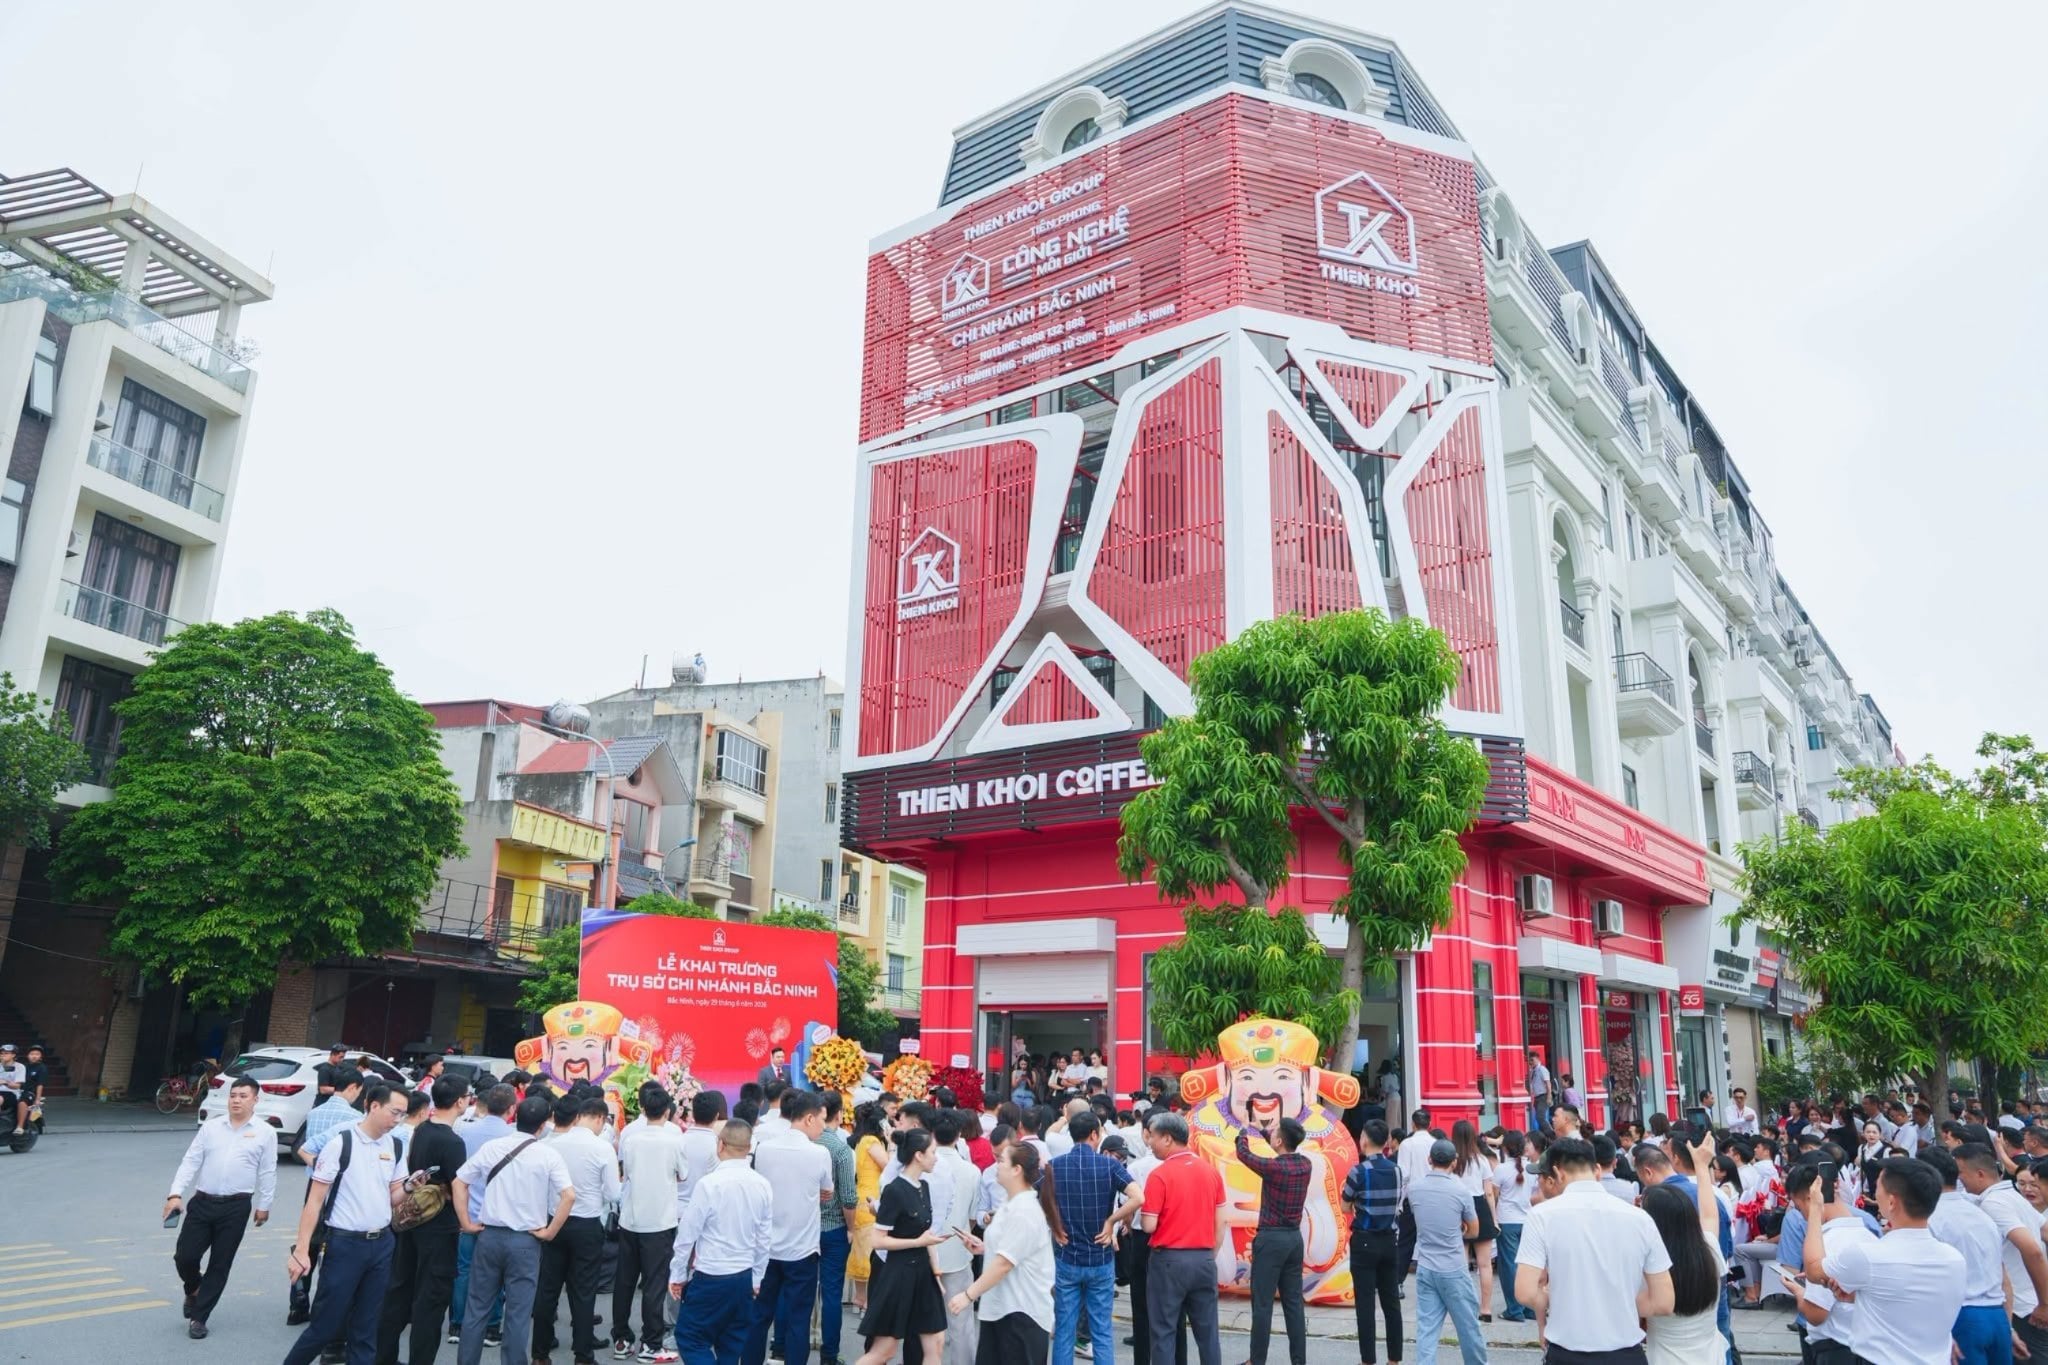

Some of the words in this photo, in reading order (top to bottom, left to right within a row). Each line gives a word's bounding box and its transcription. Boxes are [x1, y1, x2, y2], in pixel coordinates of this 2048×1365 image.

[963, 215, 1003, 241] THIEN
[1006, 198, 1046, 224] KHOI
[1049, 173, 1106, 205] GROUP
[1057, 201, 1103, 226] PHONG
[1002, 237, 1061, 275] CÔNG
[1067, 205, 1130, 249] NGHỆ
[1036, 257, 1062, 277] MÔI
[1320, 263, 1371, 288] THIEN
[1375, 275, 1420, 298] KHOI
[952, 326, 978, 348] CHI
[980, 306, 1035, 338] NHÁNH
[1038, 288, 1072, 317] BẮC
[1075, 275, 1116, 303] NINH
[966, 298, 990, 314] KHOI
[928, 596, 959, 614] KHOI
[898, 783, 970, 817] THIEN
[976, 772, 1048, 808] KHOI
[658, 952, 677, 971] LỄ
[680, 959, 716, 973] KHAI
[718, 961, 777, 977] TRƯƠNG
[607, 972, 639, 991] TRỤ
[642, 973, 667, 990] SỞ
[668, 977, 694, 991] CHI
[697, 977, 750, 994] NHÁNH
[753, 977, 782, 996] BẮC
[784, 984, 818, 998] NINH
[1682, 993, 1701, 1006] 5G
